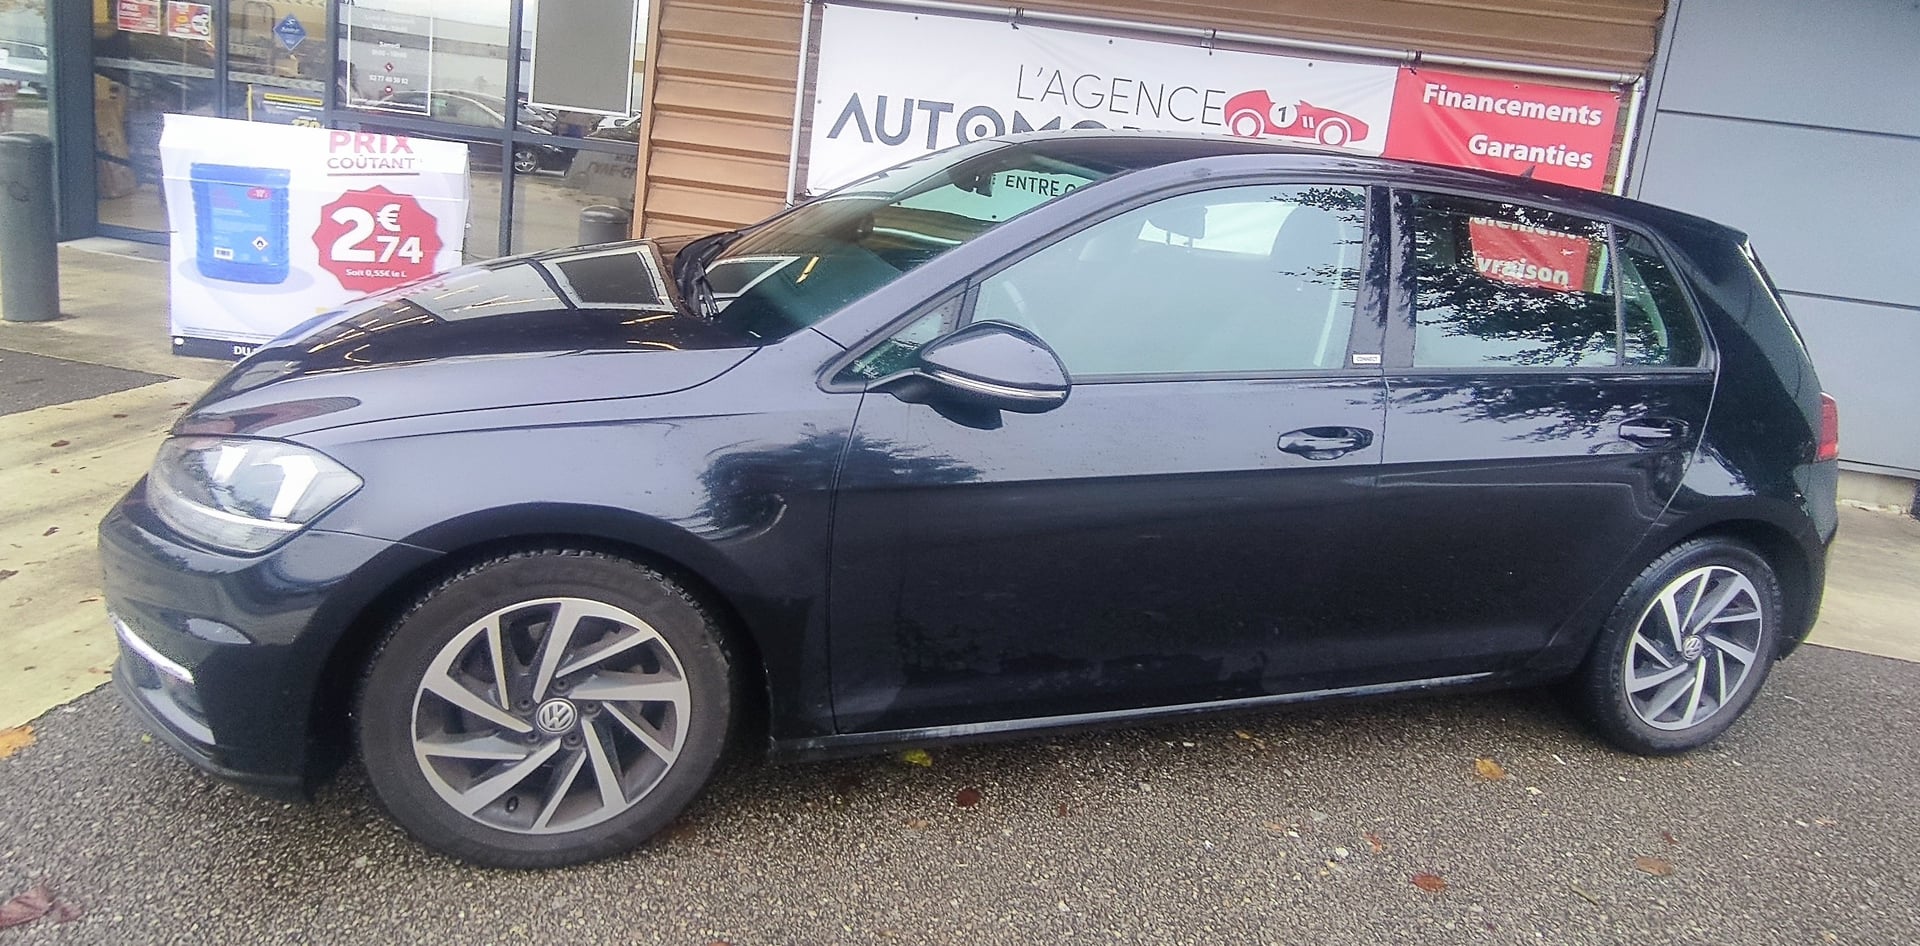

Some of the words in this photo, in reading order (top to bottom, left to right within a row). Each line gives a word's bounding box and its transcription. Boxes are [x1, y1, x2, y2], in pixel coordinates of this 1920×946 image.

[1016, 63, 1227, 126] L'AGENCE
[1423, 82, 1602, 126] Financements
[1278, 106, 1287, 122] 1
[329, 130, 414, 154] PRIX
[1468, 134, 1593, 169] Garanties
[327, 155, 416, 169] COÛTANT
[1005, 174, 1060, 197] ENTRE
[345, 268, 364, 276] Soit
